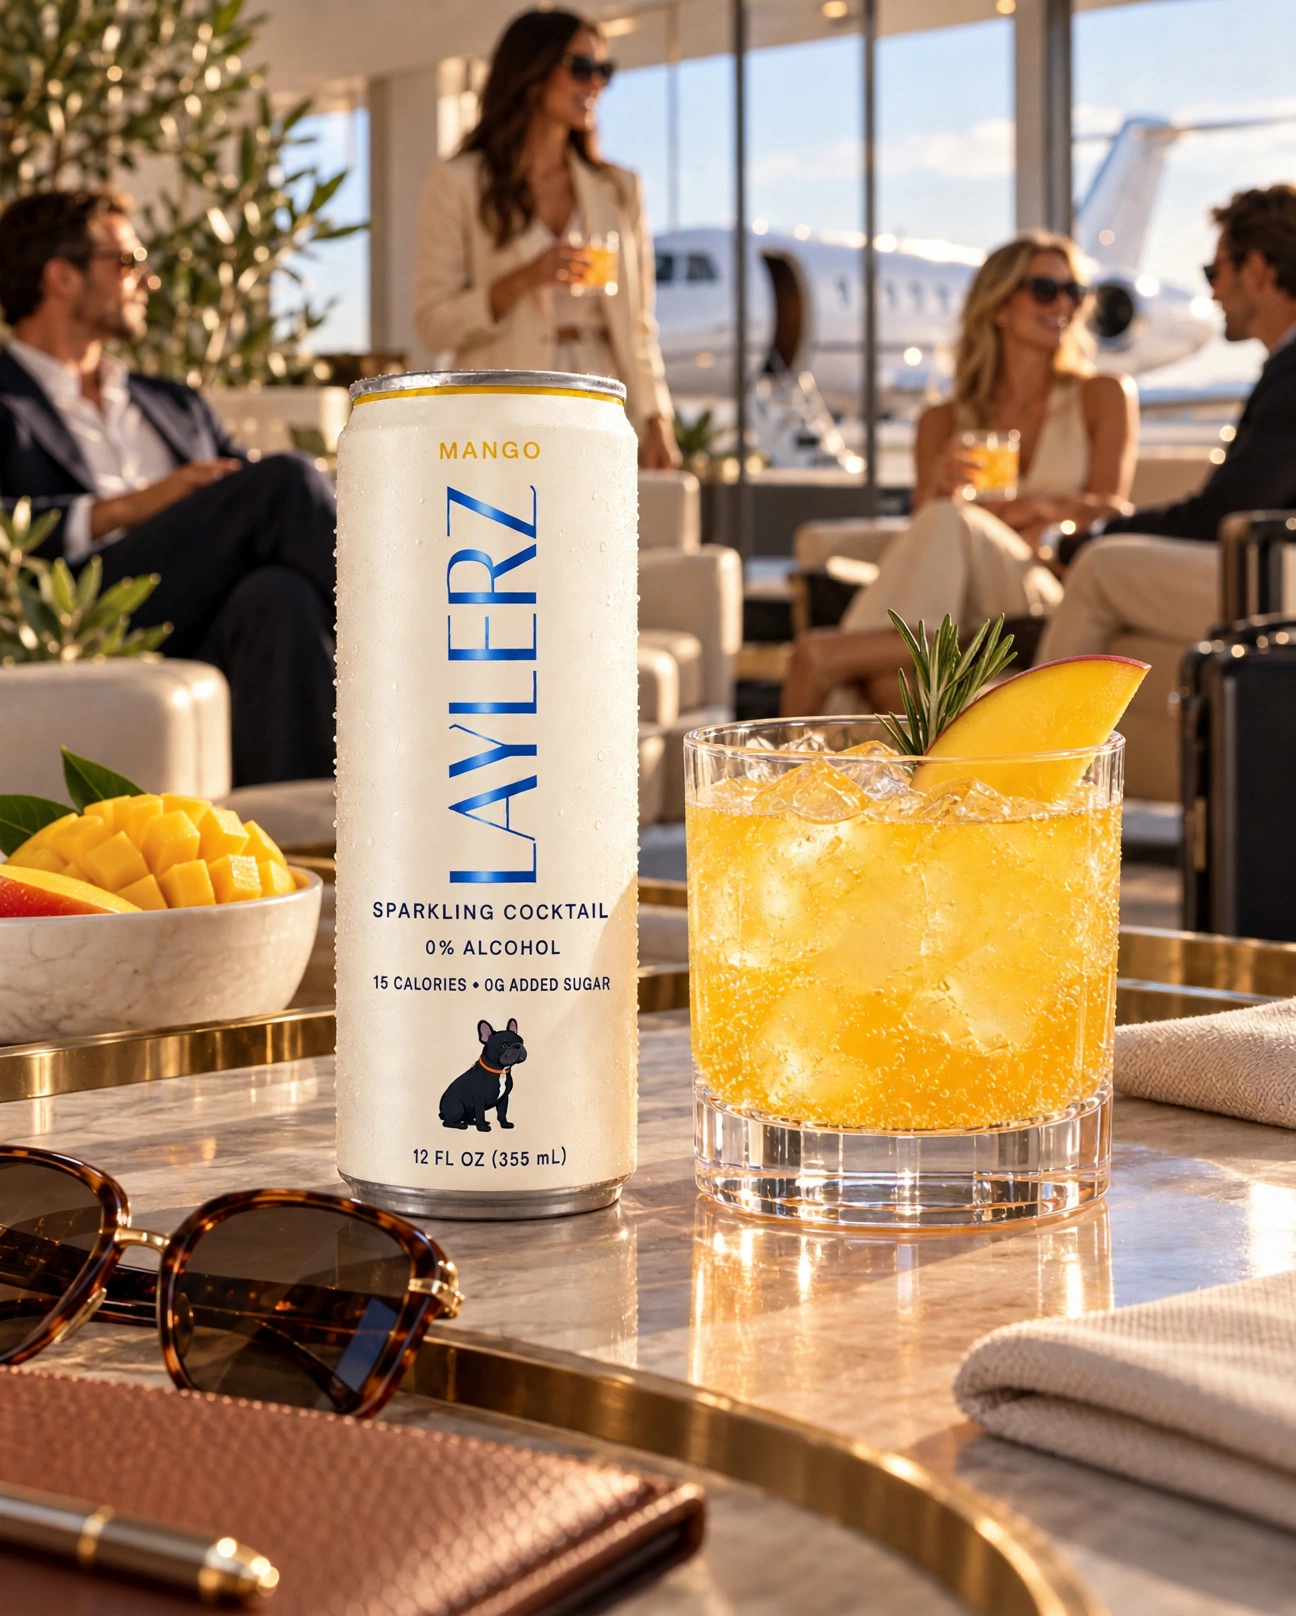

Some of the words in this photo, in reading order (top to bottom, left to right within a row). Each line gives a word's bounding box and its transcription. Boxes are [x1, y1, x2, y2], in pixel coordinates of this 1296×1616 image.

[439, 440, 541, 460] MANGO
[446, 485, 538, 884] LAYLERZ
[372, 901, 494, 921] SPARKLING
[503, 902, 609, 921] COCKTAIL
[425, 939, 455, 956] 0%
[462, 939, 561, 956] ALCOHOL
[373, 975, 389, 990] 15
[393, 975, 467, 992] CALORIES
[484, 977, 505, 992] 0G
[508, 977, 559, 992] ADDED
[563, 976, 611, 992] SUGAR
[413, 1148, 429, 1165] 12
[435, 1150, 454, 1167] FL
[461, 1151, 485, 1167] OZ
[492, 1149, 530, 1170] (355
[536, 1146, 567, 1166] mL)
